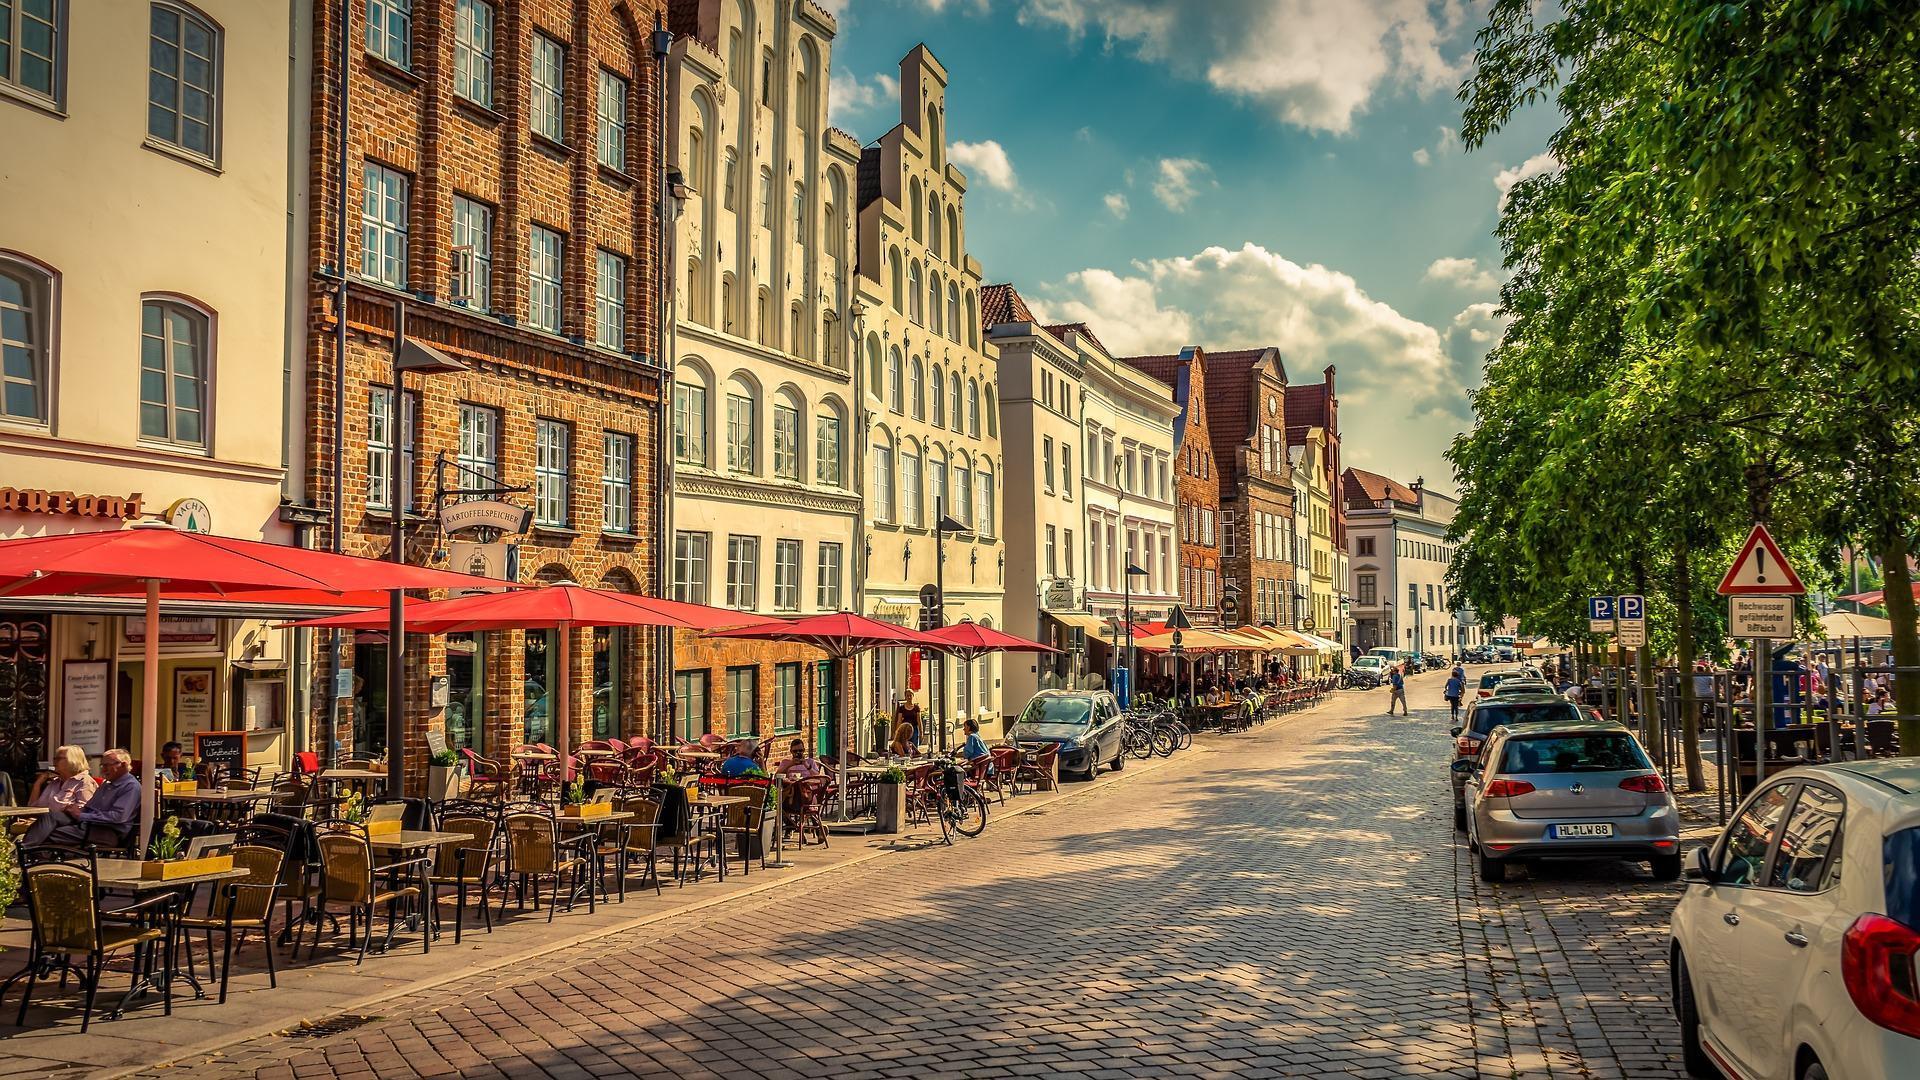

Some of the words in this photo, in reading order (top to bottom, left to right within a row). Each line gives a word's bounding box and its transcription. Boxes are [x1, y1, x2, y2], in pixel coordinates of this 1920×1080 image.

[445, 509, 519, 524] KARTOFFELSPEICHER
[1595, 600, 1608, 618] P
[1624, 598, 1639, 618] P
[1738, 601, 1784, 610] Hochwasser
[1739, 612, 1784, 623] gefährdeter
[1747, 623, 1777, 632] Bereich
